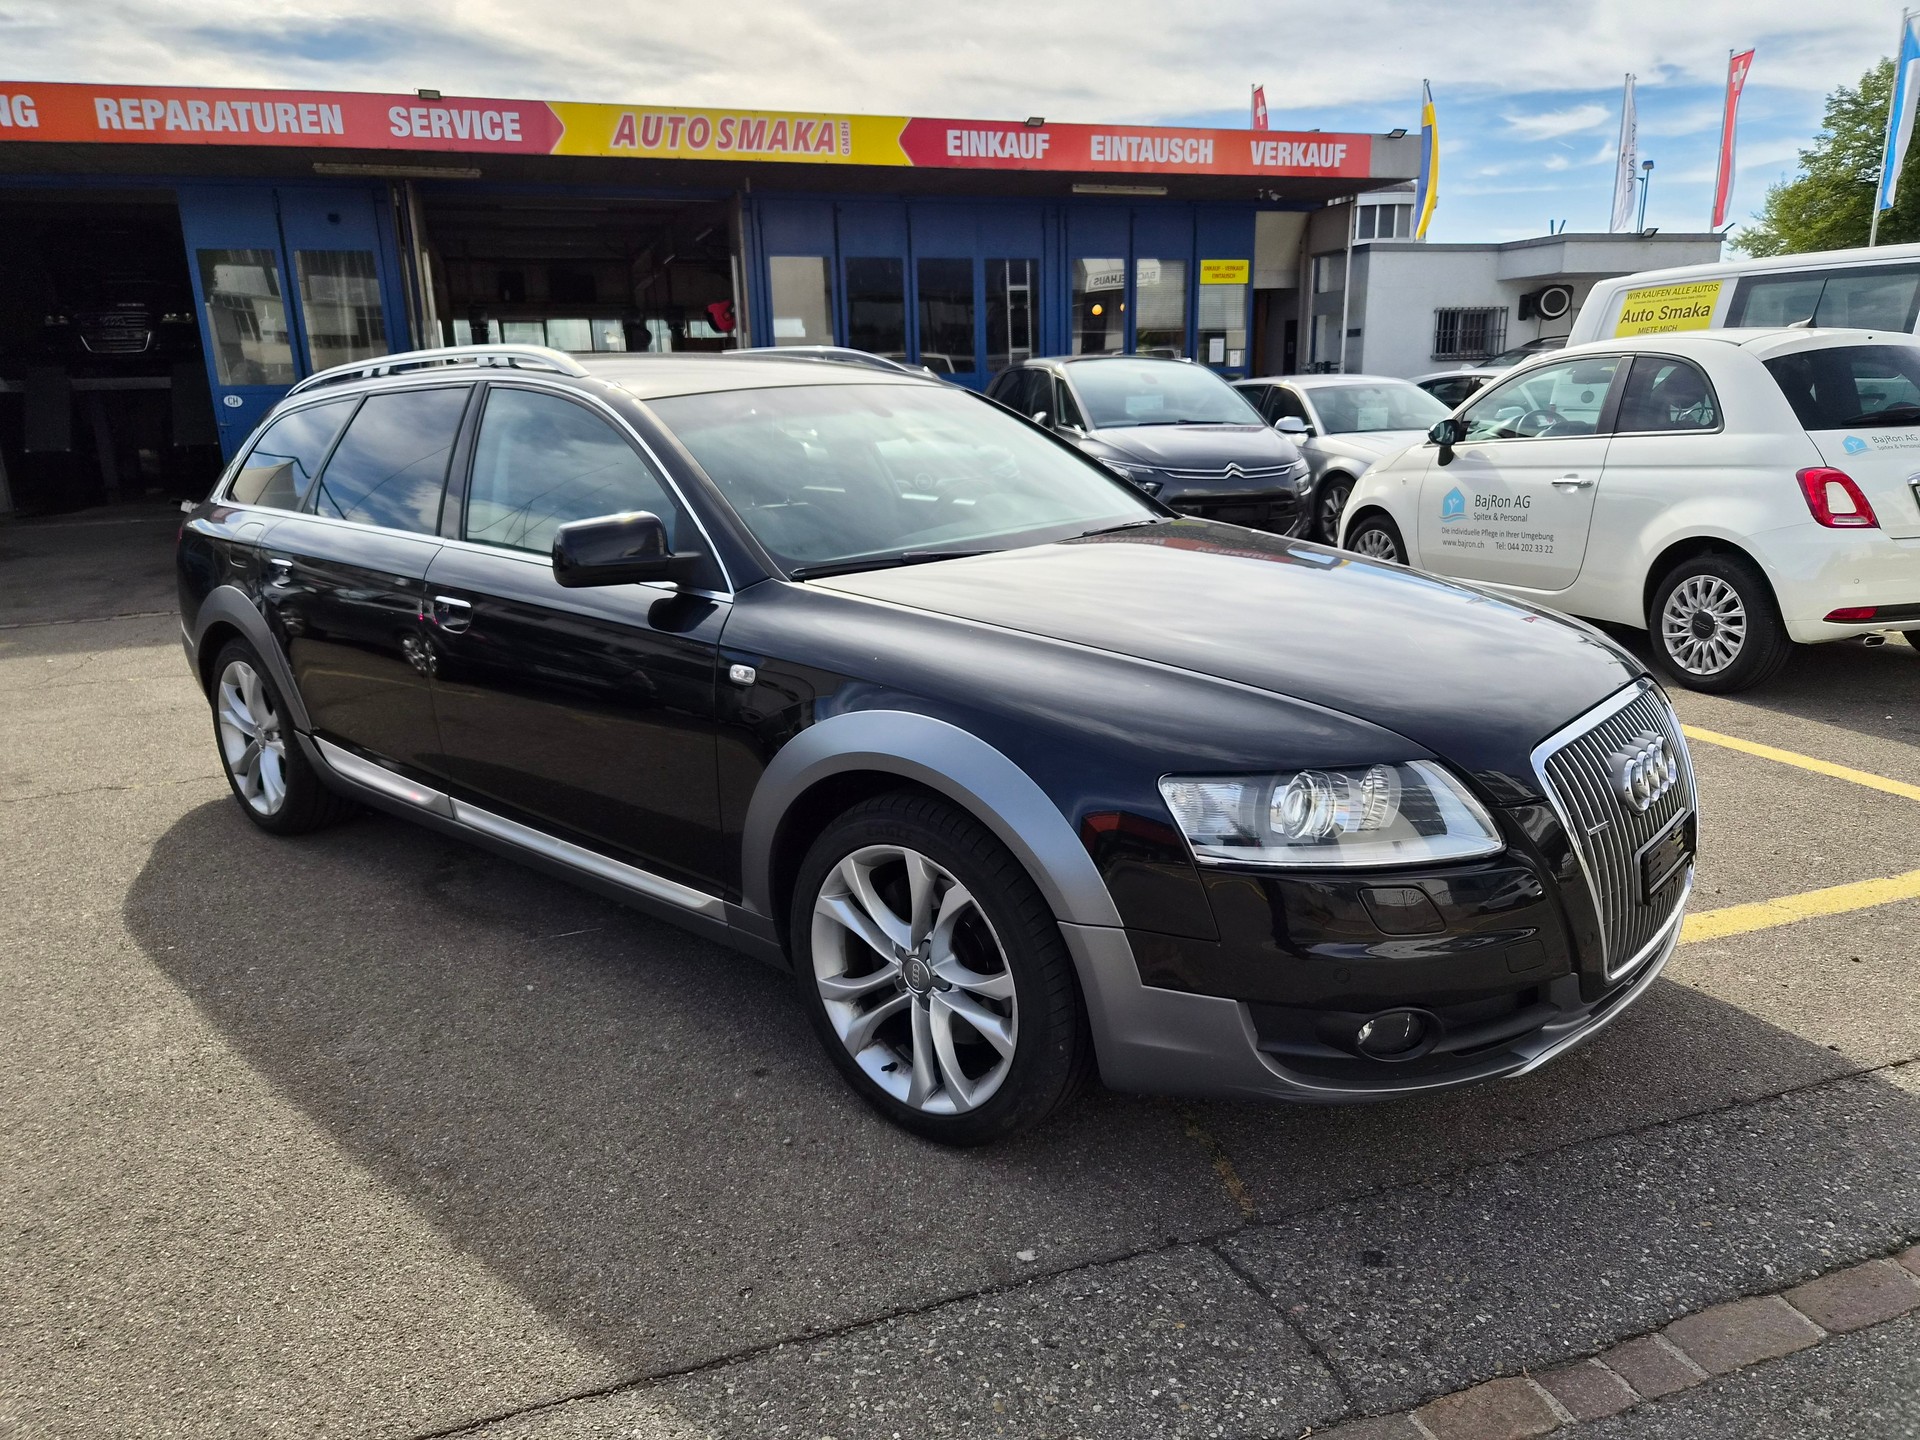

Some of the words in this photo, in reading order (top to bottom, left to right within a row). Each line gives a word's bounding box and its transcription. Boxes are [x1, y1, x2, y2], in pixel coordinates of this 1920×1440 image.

[0, 94, 39, 127] G
[94, 97, 344, 135] REPARATUREN
[388, 106, 522, 141] SERVICE
[840, 121, 850, 156] GMBH
[946, 129, 1050, 160] EINKAUF
[1090, 134, 1214, 164] EINTAUSCH
[1250, 140, 1347, 168] VERKAUF
[1627, 292, 1641, 300] WIR
[1641, 288, 1671, 298] KAUFEN
[1672, 286, 1691, 295] ALLE
[1692, 283, 1719, 294] AUTOS
[1620, 308, 1654, 323] Auto
[1658, 302, 1711, 320] Smaka
[1637, 325, 1658, 334] MIETE
[1659, 324, 1678, 333] MICH
[227, 396, 239, 406] CH
[1905, 433, 1919, 442] AG
[1474, 494, 1511, 510] BajRon
[1513, 495, 1531, 508] AG
[1473, 512, 1491, 522] Spitex
[1500, 513, 1528, 522] Personal
[1441, 526, 1450, 534] Die
[1451, 527, 1480, 536] individuelle
[1481, 528, 1498, 538] Pflege
[1505, 530, 1519, 538] Ihrer
[1521, 531, 1554, 542] Umgebung
[1442, 538, 1485, 549] www.bajron.ch
[1496, 541, 1507, 550] Tel:
[1507, 542, 1519, 551] 044
[1521, 543, 1533, 552] 202
[1534, 544, 1543, 553] 33
[1544, 544, 1554, 553] 22
